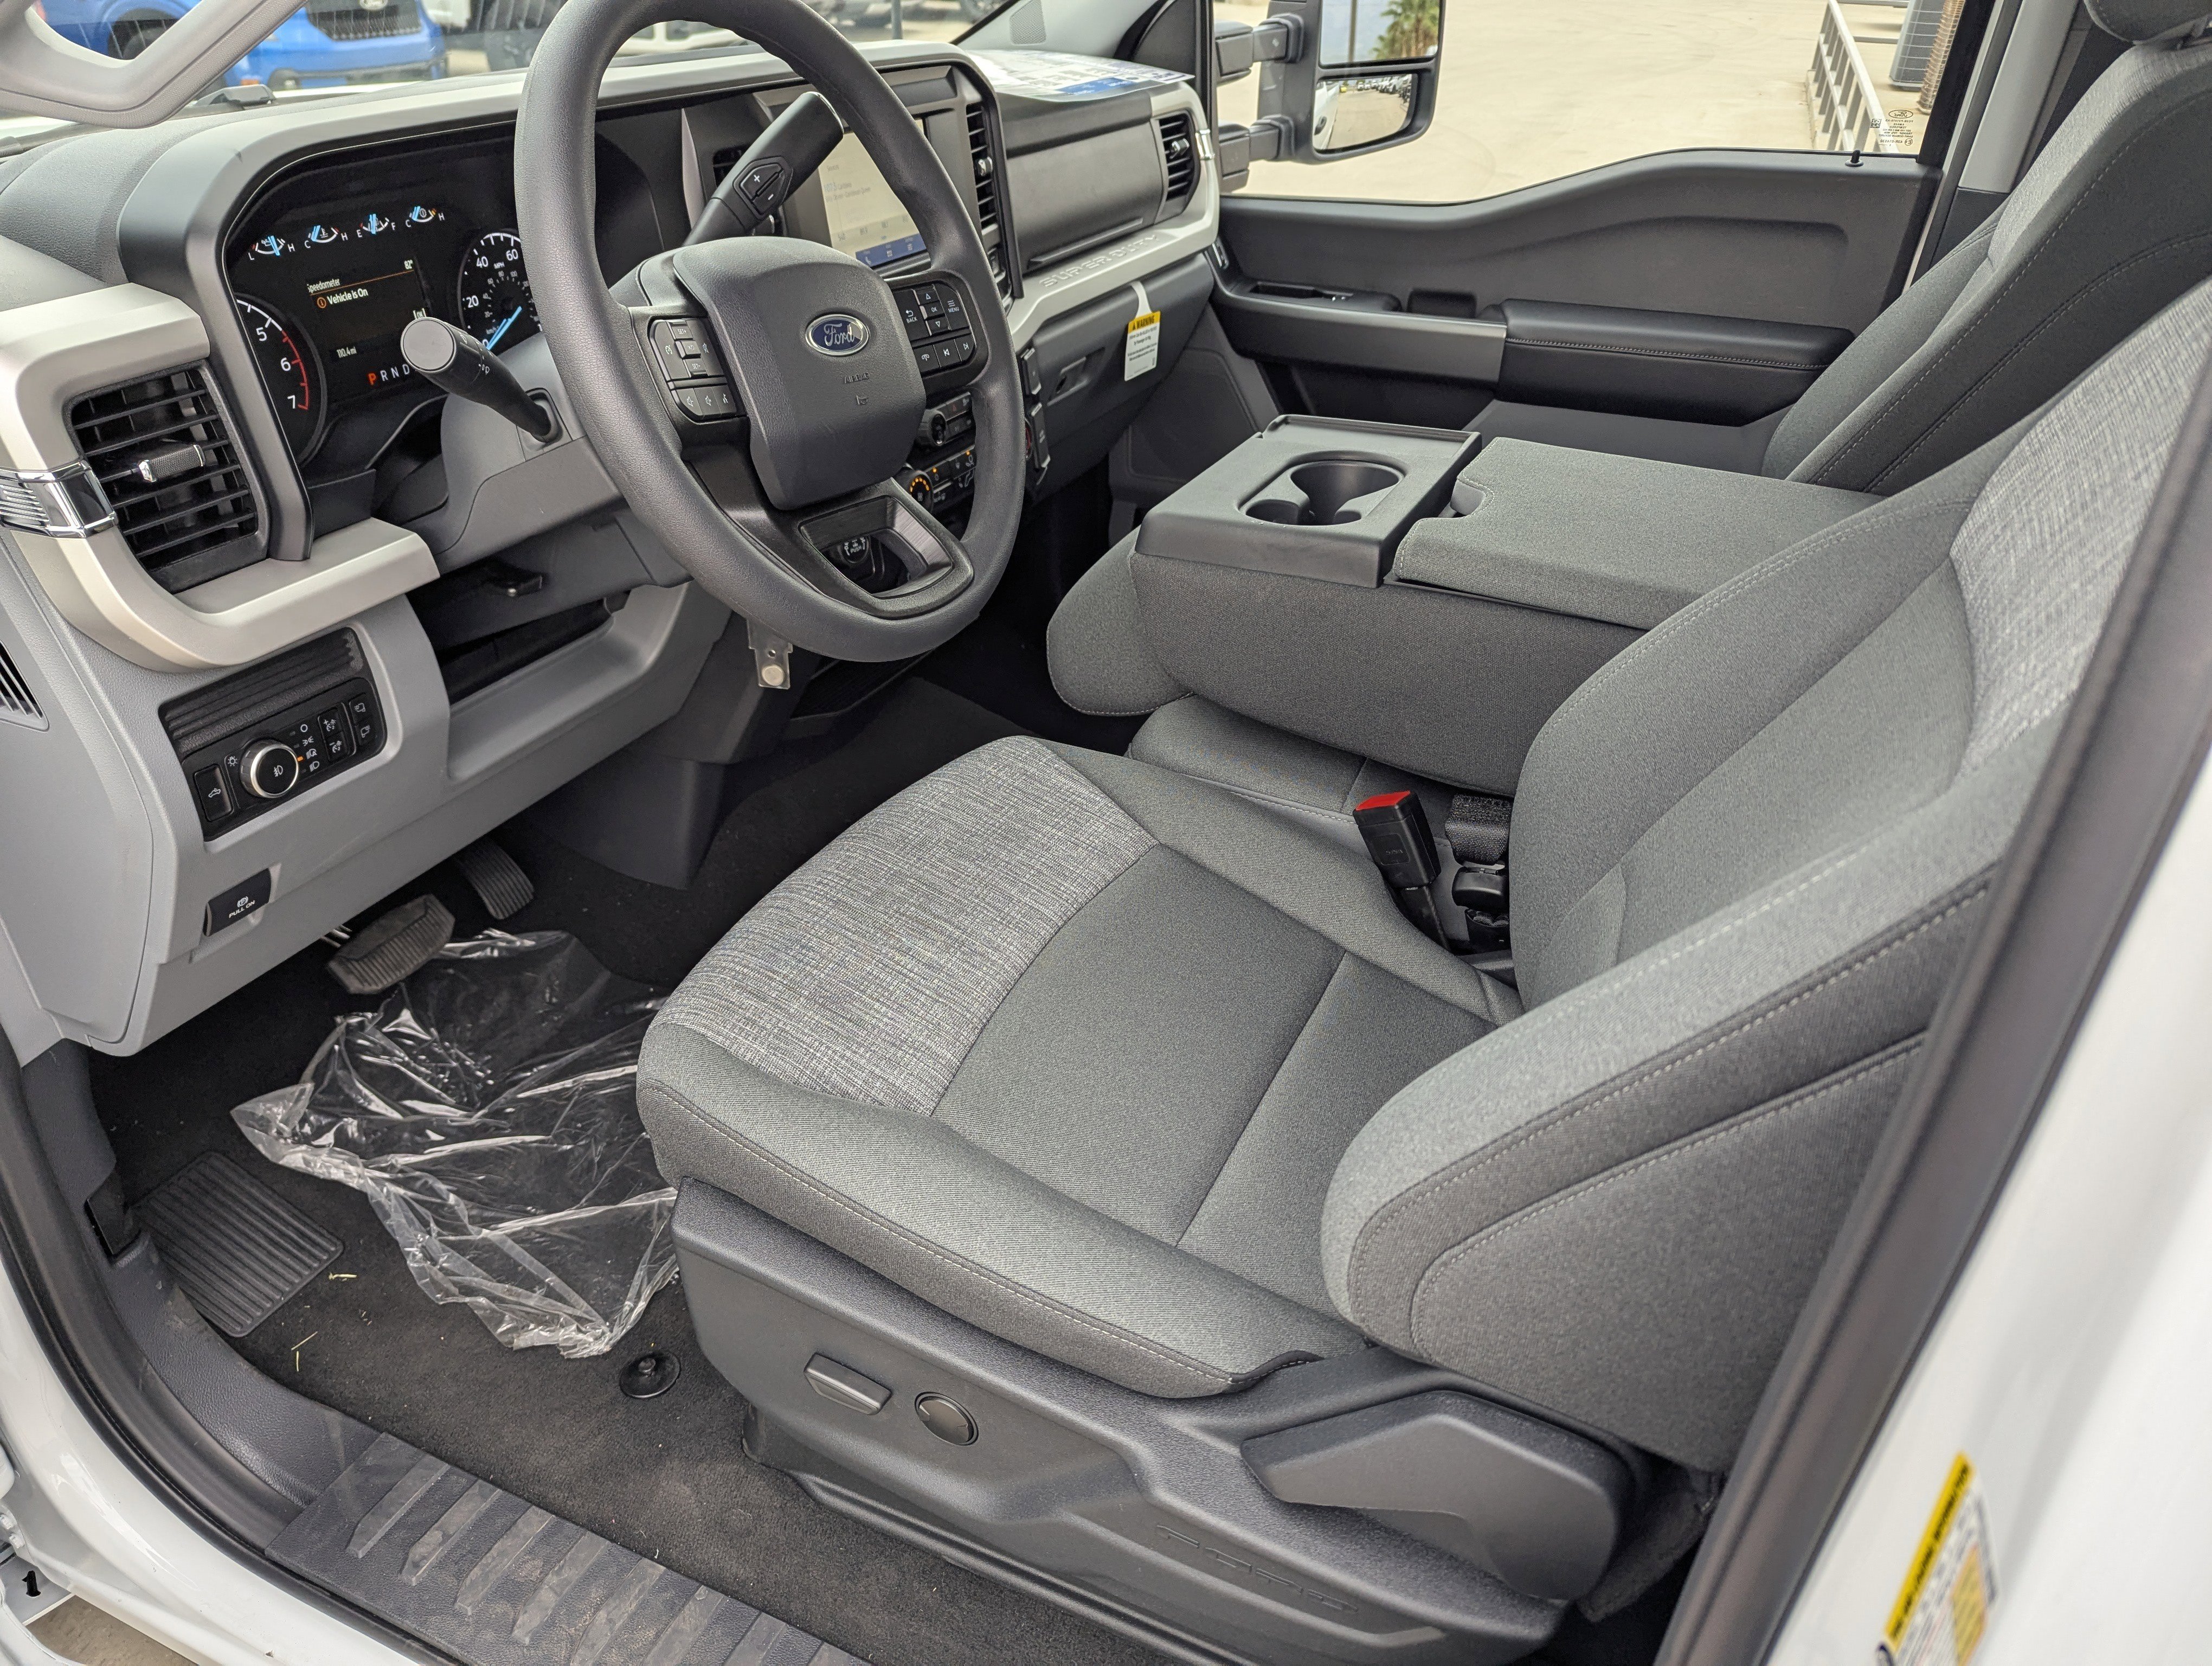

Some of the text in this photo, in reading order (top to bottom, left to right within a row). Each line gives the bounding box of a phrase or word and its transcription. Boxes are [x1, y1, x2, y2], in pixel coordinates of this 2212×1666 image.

[438, 213, 445, 221] H
[391, 222, 396, 231] F
[406, 219, 412, 228] C
[341, 232, 349, 241] H
[357, 229, 363, 238] E
[287, 243, 295, 253] H
[304, 240, 311, 248] C
[248, 252, 254, 261] L
[506, 249, 518, 261] 60
[476, 256, 488, 268] 40
[327, 291, 352, 305] Vehicle
[357, 288, 369, 297] On
[466, 295, 479, 308] 20
[256, 327, 267, 342] 5
[824, 323, 855, 347] Ford
[336, 348, 350, 358] 110.4
[280, 357, 291, 371] 6
[367, 363, 410, 386] P R N D
[287, 395, 295, 409] 7
[229, 900, 255, 918] PULL ON
